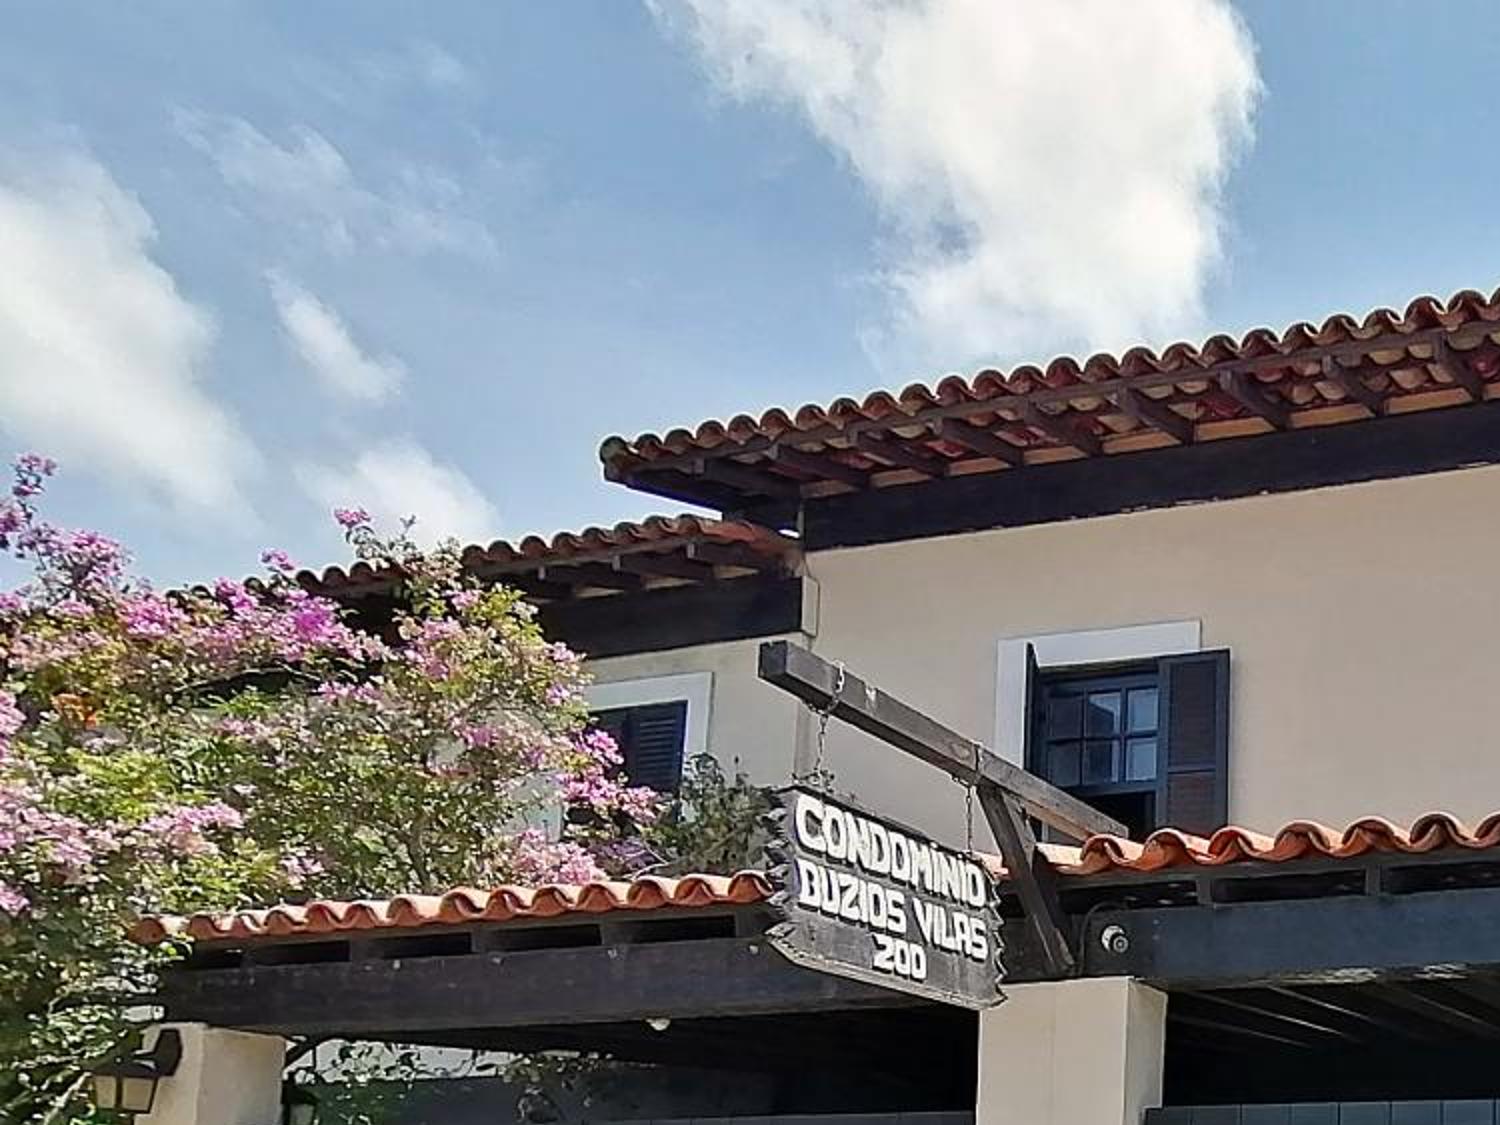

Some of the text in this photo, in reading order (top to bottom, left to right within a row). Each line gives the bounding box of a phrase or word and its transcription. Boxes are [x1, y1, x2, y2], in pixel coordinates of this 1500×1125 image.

[798, 858, 989, 960] BUZIOS VILAS
[871, 933, 927, 980] 200
